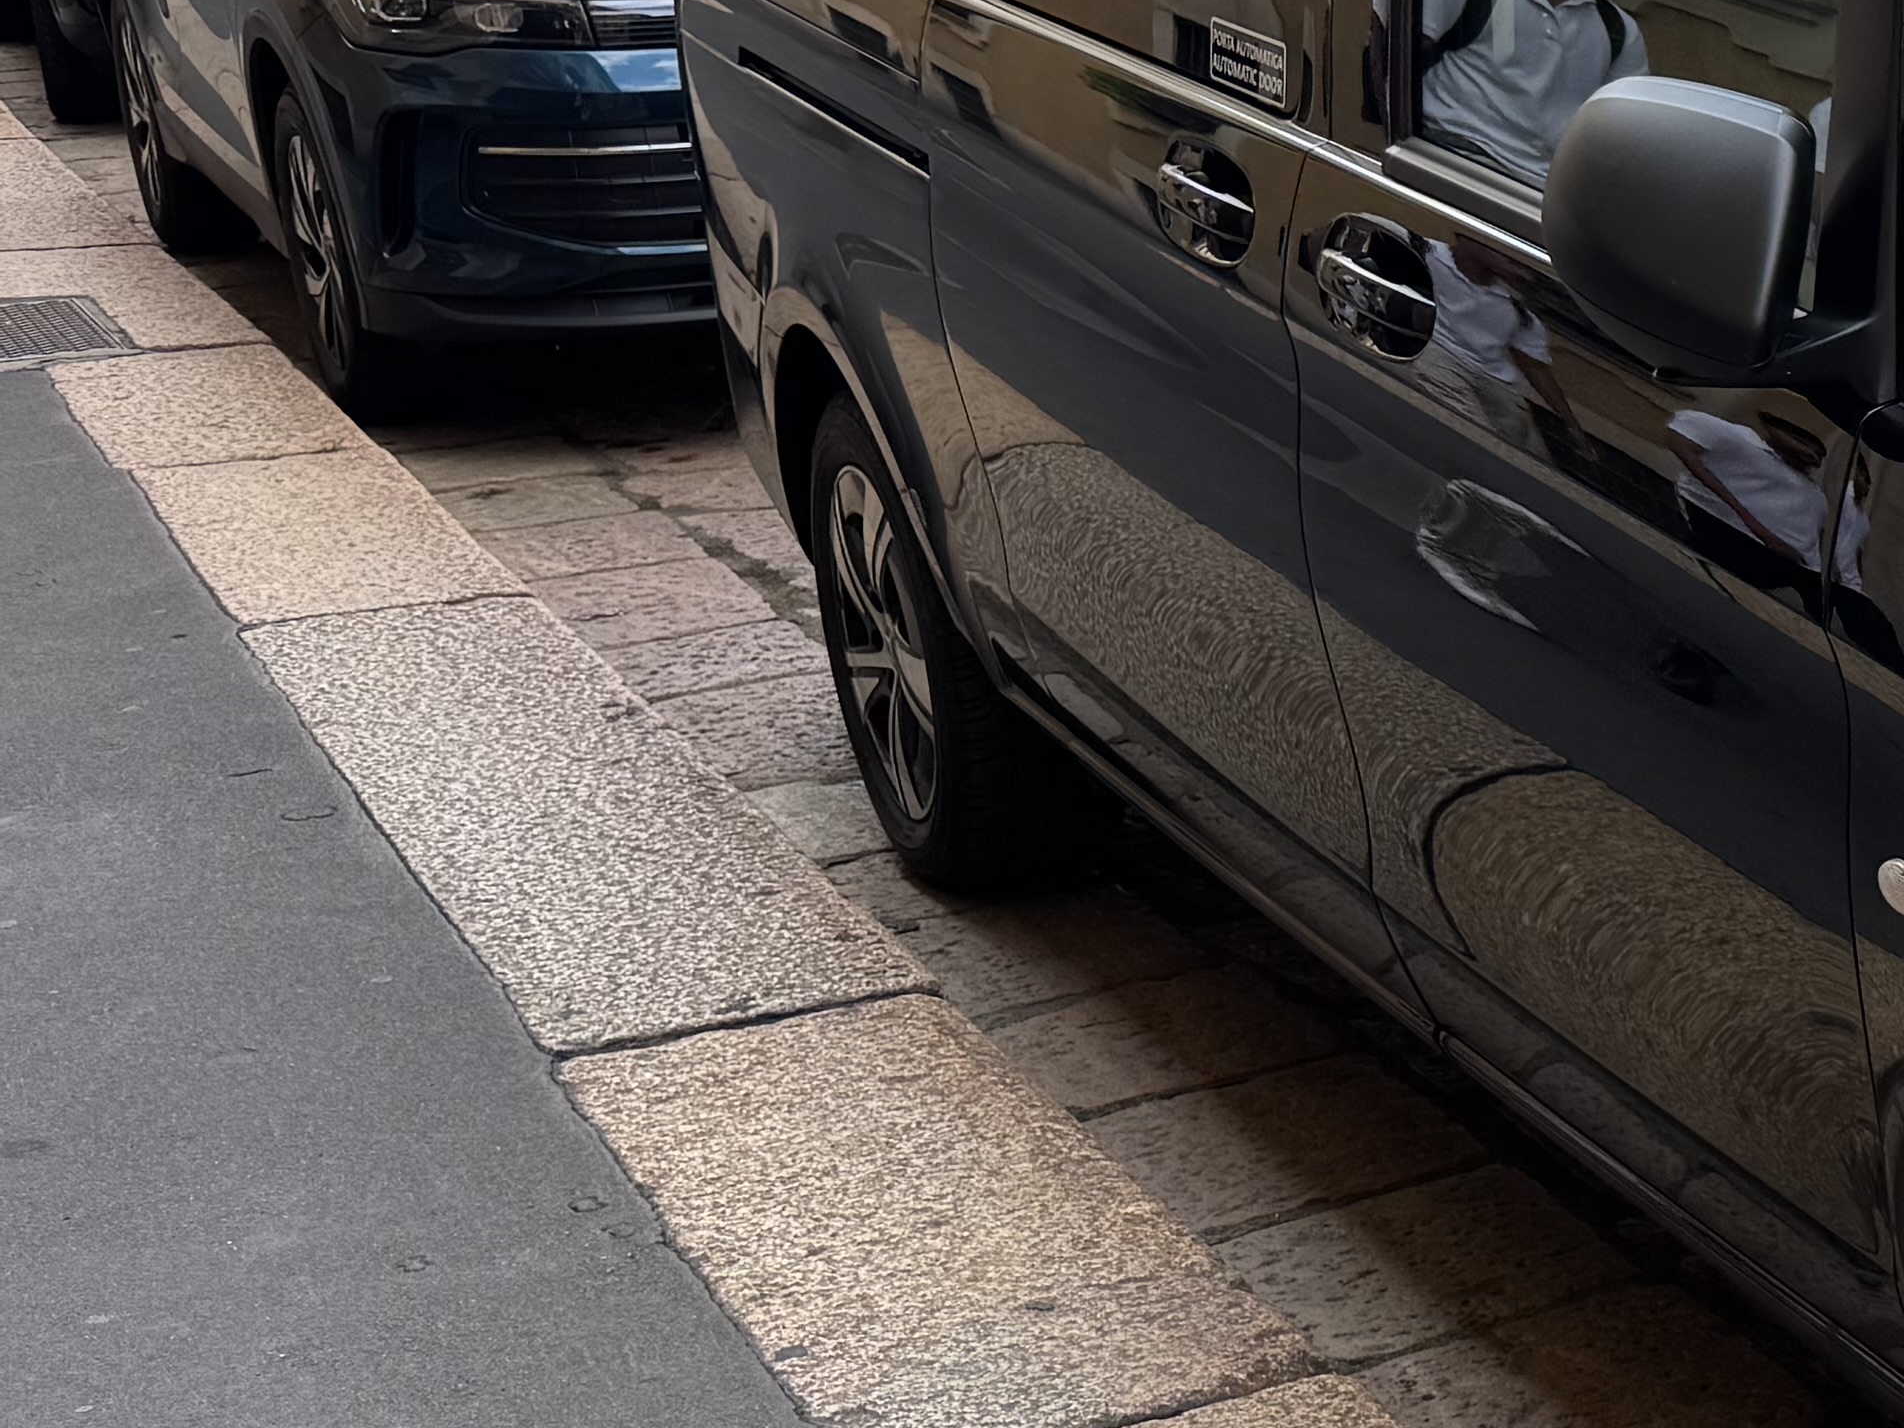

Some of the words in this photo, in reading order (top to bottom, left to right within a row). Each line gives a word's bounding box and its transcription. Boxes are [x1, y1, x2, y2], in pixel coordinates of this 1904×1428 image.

[1213, 28, 1235, 51] PORTA
[1236, 39, 1283, 71] AUTOMATICA
[1213, 53, 1258, 87] AUTOMATIC
[1258, 70, 1283, 97] DOOR
